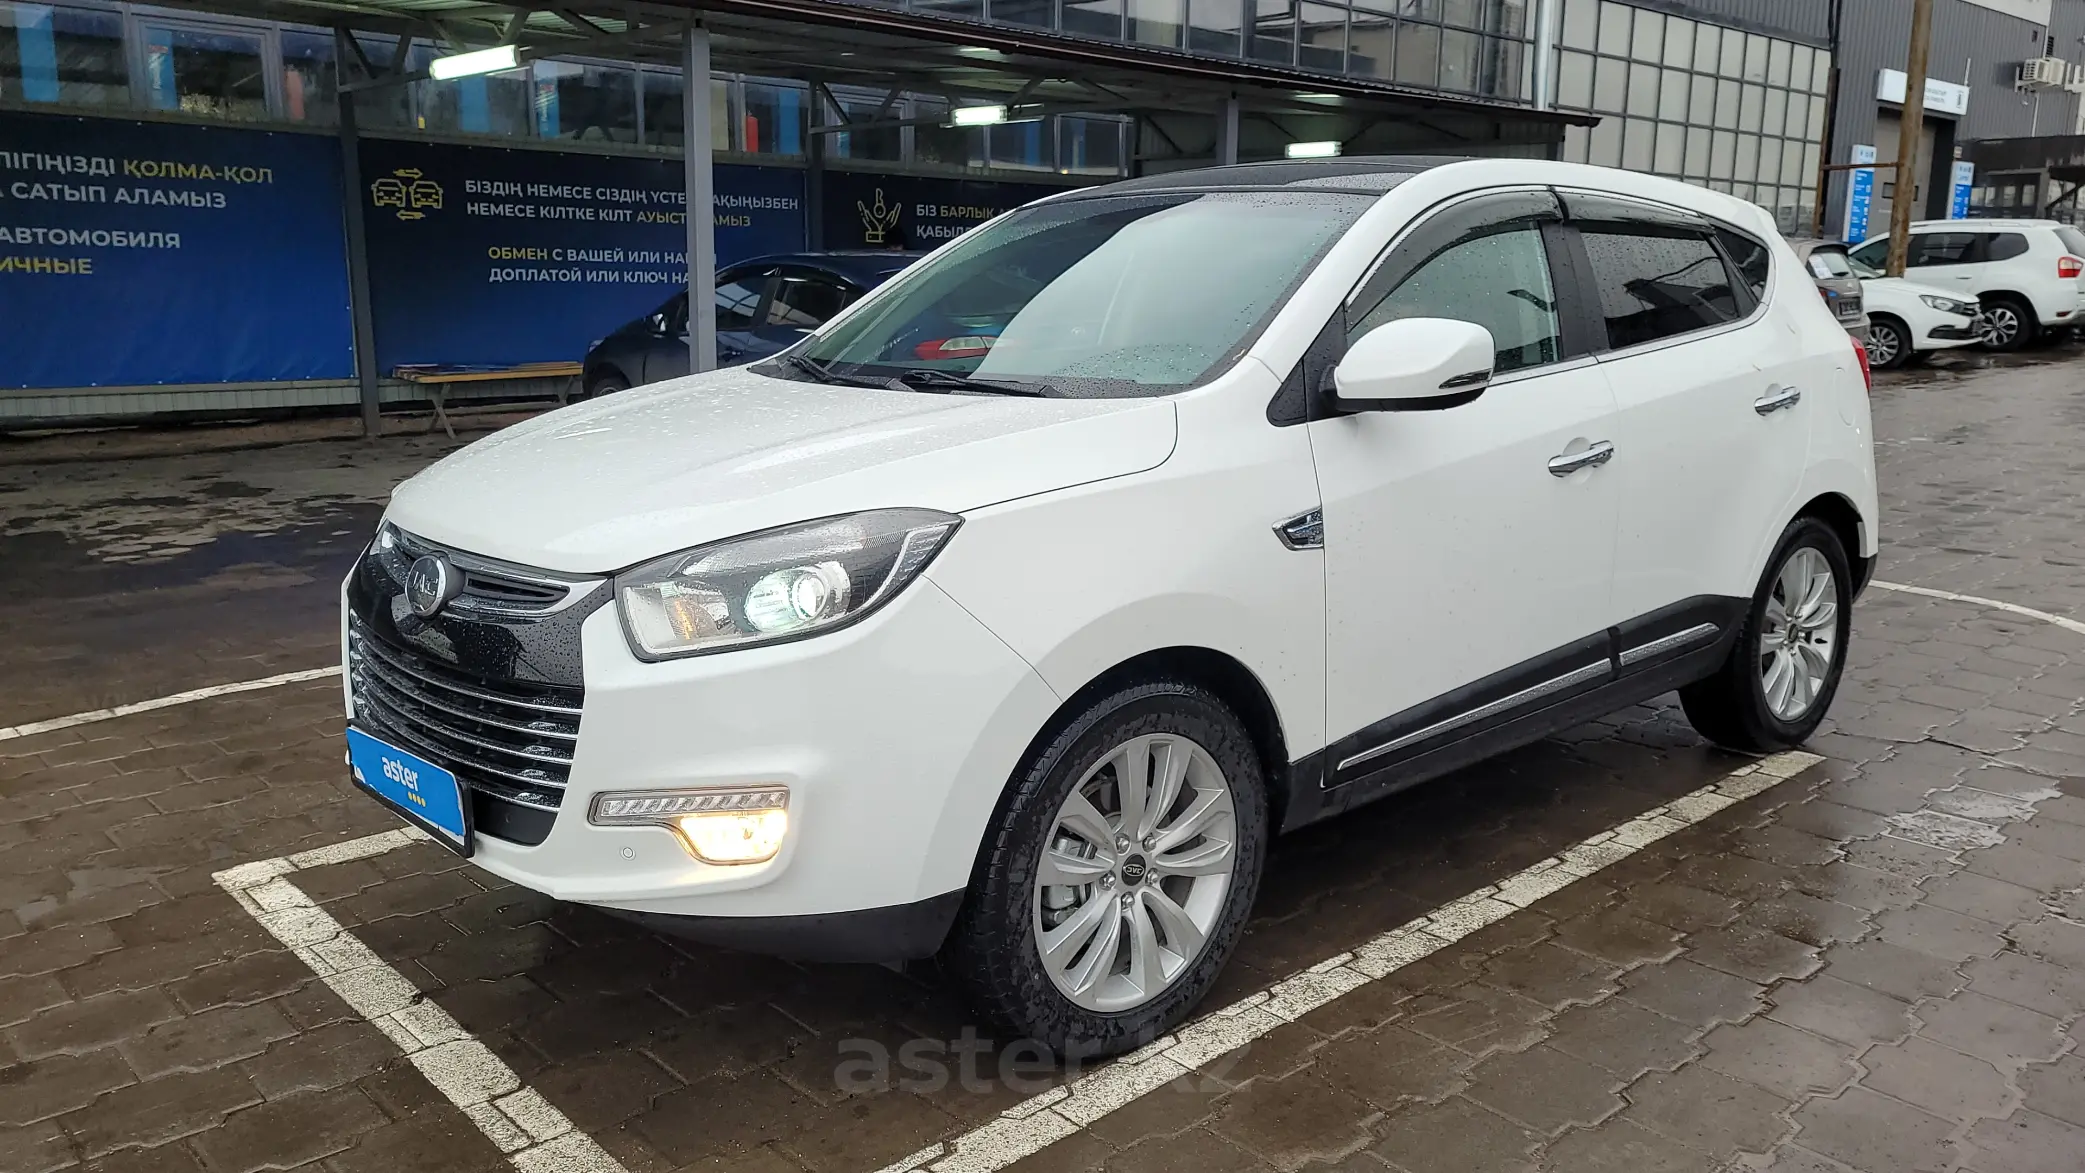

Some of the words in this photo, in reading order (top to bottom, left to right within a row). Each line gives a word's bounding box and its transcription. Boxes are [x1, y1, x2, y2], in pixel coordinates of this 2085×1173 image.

[123, 159, 273, 184] ҚОЛМА-ҚОЛ
[11, 181, 106, 203] САТЫП
[114, 187, 227, 209] АЛАМЫЗ
[465, 179, 524, 198] БІЗДІҢ
[527, 183, 592, 199] НЕМЕСЕ
[595, 187, 648, 204] СІЗДІҢ
[466, 202, 536, 218] НЕМЕСЕ
[540, 206, 595, 221] КІЛТКЕ
[599, 208, 633, 222] КІЛТ
[916, 204, 937, 217] БІЗ
[0, 226, 181, 250] АВТОМОБИЛЯ
[488, 246, 548, 261] ОБМЕН
[552, 249, 563, 261] С
[567, 247, 624, 263] ВАШЕЙ
[628, 251, 660, 264] ИЛИ
[488, 267, 582, 283] ДОПЛАТОЙ
[586, 270, 620, 283] ИЛИ
[624, 271, 668, 284] КЛЮЧ
[381, 756, 419, 792] aster
